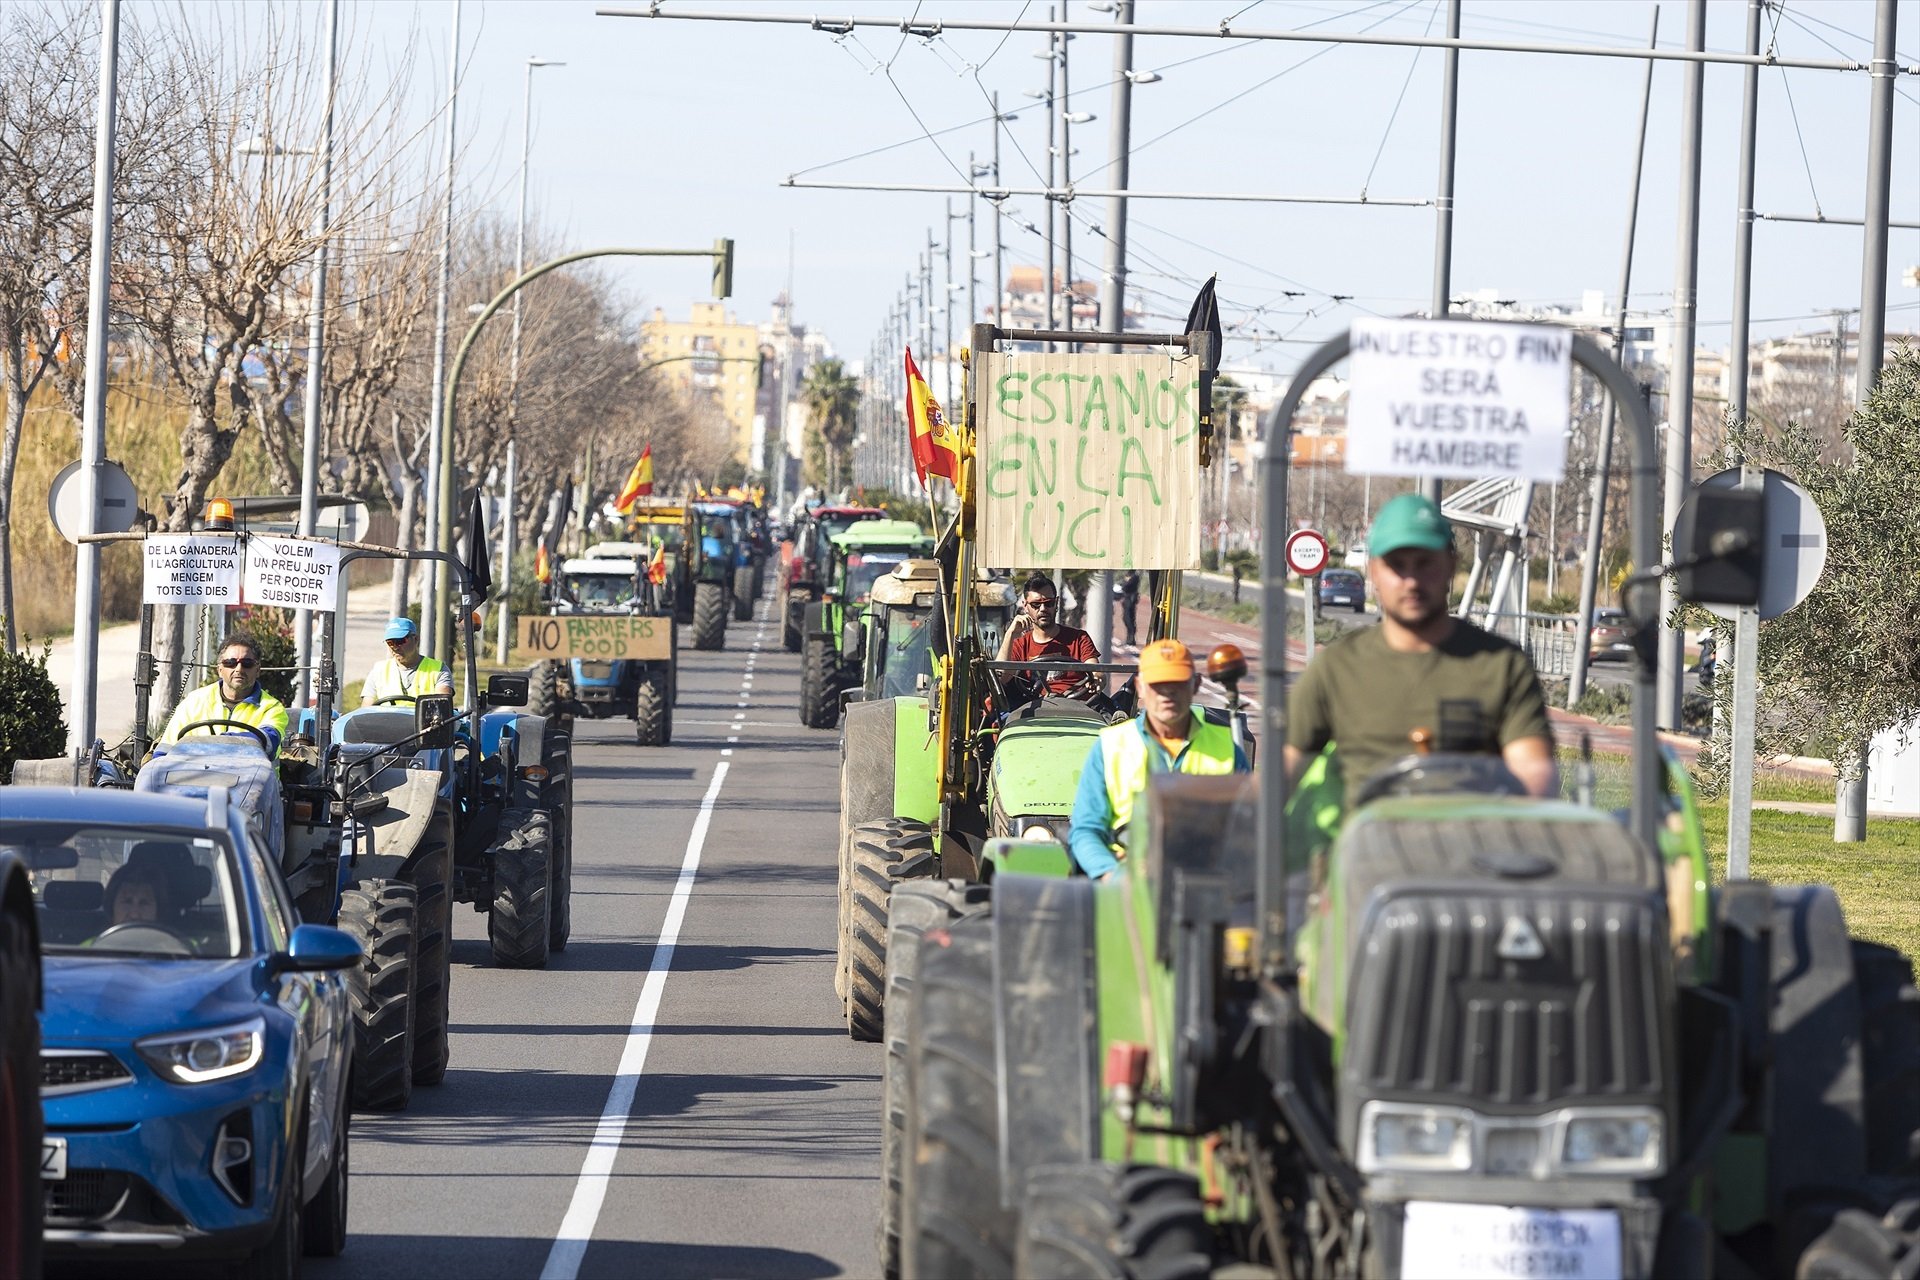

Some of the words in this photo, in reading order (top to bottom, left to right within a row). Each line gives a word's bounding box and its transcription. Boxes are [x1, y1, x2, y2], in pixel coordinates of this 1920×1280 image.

[1515, 335, 1563, 364] FIN
[996, 369, 1199, 446] ESTAMOS
[1389, 402, 1530, 434] VUESTRA
[1391, 438, 1523, 470] HAMBRE
[987, 432, 1057, 498] EN
[1075, 435, 1162, 506] LA
[1022, 500, 1133, 568] UCI
[148, 545, 161, 555] DE
[164, 545, 177, 555] LA
[179, 545, 238, 556] GANADERIA
[274, 544, 313, 558] VOLEM
[150, 559, 154, 569] I
[156, 559, 234, 569] L'AGRICULTURA
[253, 557, 268, 569] UN
[271, 558, 301, 572] PREU
[304, 562, 333, 576] JUST
[171, 572, 214, 582] MENGEM
[260, 573, 281, 586] PER
[284, 575, 323, 590] PODER
[156, 586, 182, 596] TOTS
[184, 586, 203, 596] ELS
[205, 586, 228, 596] DIES
[261, 588, 319, 605] SUBSISTIR
[528, 619, 560, 651] NO
[566, 617, 654, 639] FARMERS
[569, 638, 628, 657] FOOD
